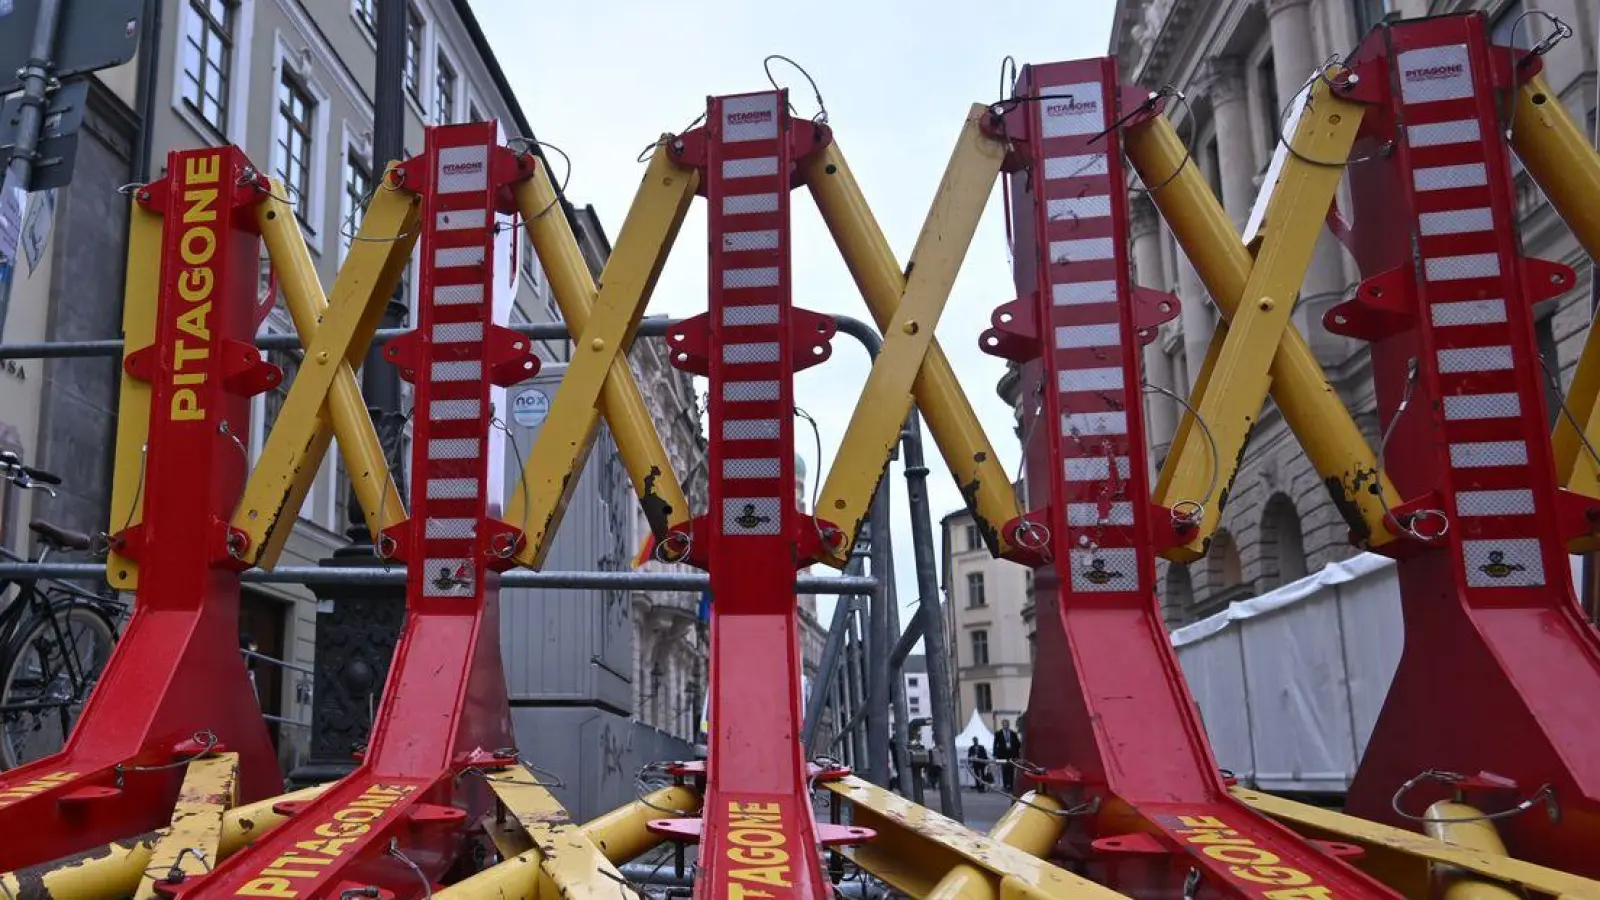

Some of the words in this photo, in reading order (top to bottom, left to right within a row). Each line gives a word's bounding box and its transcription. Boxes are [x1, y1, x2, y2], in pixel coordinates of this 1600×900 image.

[1405, 64, 1463, 77] PITAGONE
[727, 111, 772, 121] PITAGONE
[443, 162, 482, 172] PITAGONE
[171, 155, 220, 421] PITAGONE
[515, 396, 544, 406] nox
[234, 784, 417, 898] PITAGONE
